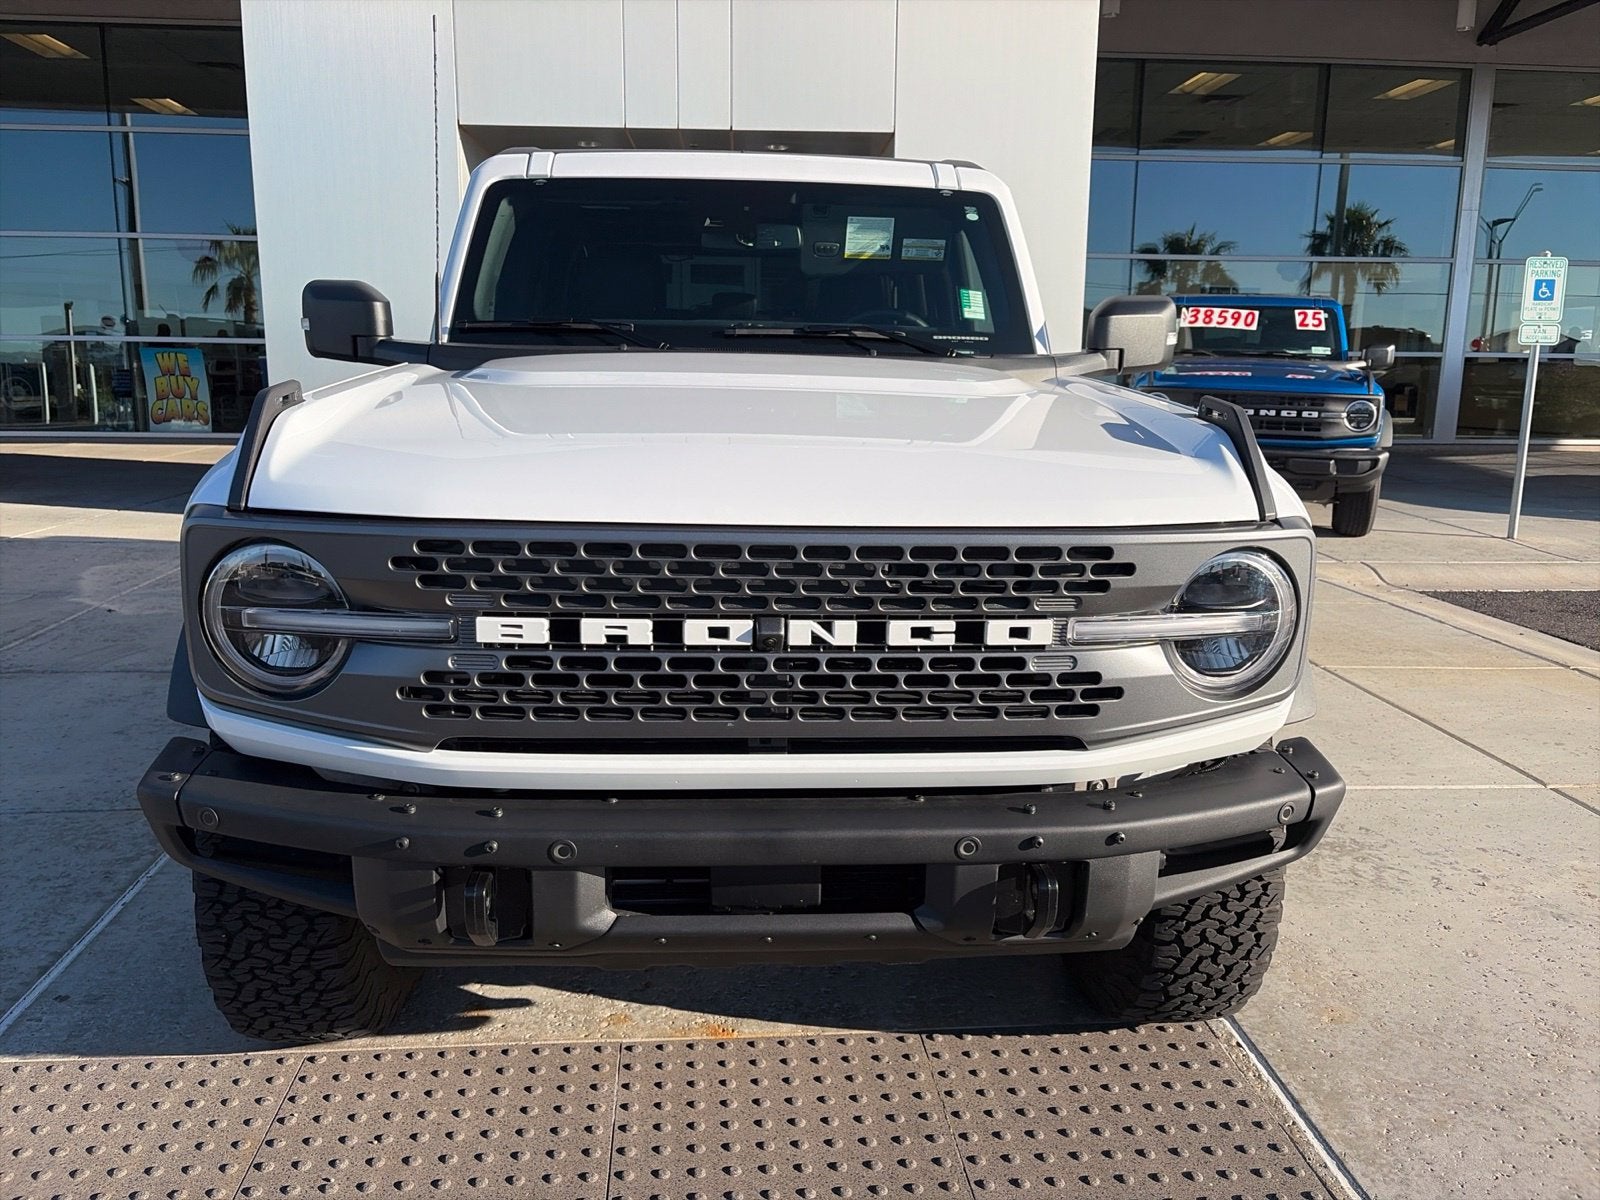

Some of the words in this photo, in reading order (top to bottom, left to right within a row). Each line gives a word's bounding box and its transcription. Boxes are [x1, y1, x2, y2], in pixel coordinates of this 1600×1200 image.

[1529, 260, 1565, 269] RESERVED
[1530, 269, 1561, 278] PARKING
[1297, 311, 1323, 327] 25
[155, 352, 192, 377] WE
[154, 375, 200, 401] BUY
[151, 398, 210, 426] CARS
[1244, 408, 1319, 419] ONCO
[475, 616, 1054, 647] BRONCO
